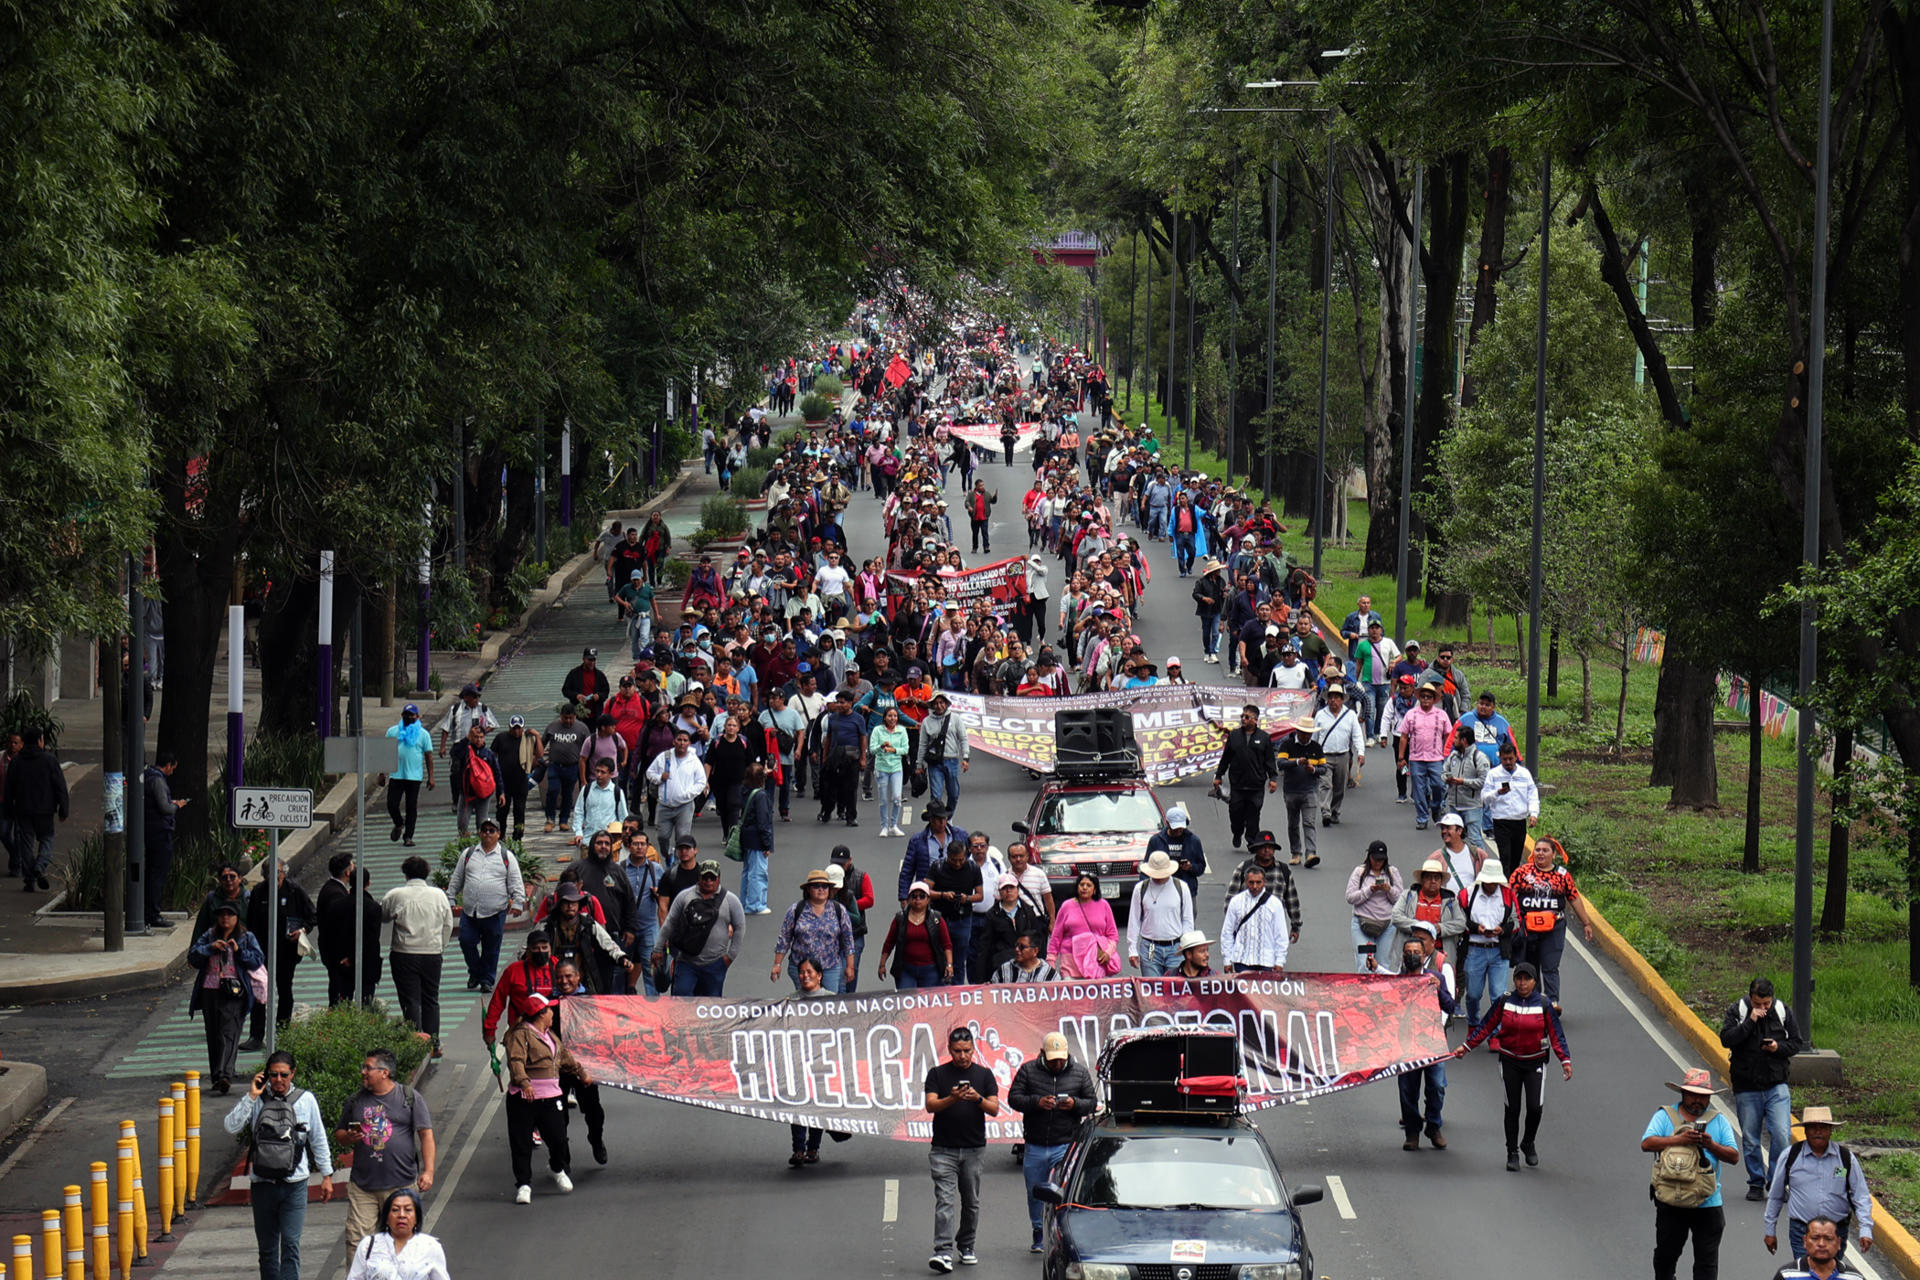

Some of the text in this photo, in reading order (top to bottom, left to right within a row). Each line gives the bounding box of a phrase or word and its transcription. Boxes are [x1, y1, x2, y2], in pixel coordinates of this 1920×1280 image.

[959, 577, 1007, 592] VILLARREAL
[1061, 693, 1098, 702] NACIONAL
[1126, 685, 1183, 696] TRABAJADORES
[966, 728, 1054, 744] ABROG
[1142, 723, 1220, 741] TOTAL
[984, 738, 1057, 753] REFO
[1142, 740, 1176, 752] LA
[1143, 752, 1168, 763] EL
[1173, 739, 1225, 760] 200
[1145, 762, 1180, 771] dos,
[288, 804, 308, 813] CRUCE
[280, 814, 308, 823] CICLISTA
[1522, 897, 1559, 909] CNTE
[696, 977, 1306, 1019] COORDINADORA NACIONAL DE TRABAJADORES DE LA EDUCACIÓN
[730, 1024, 940, 1109] HUELGA
[799, 1114, 824, 1129] DEL
